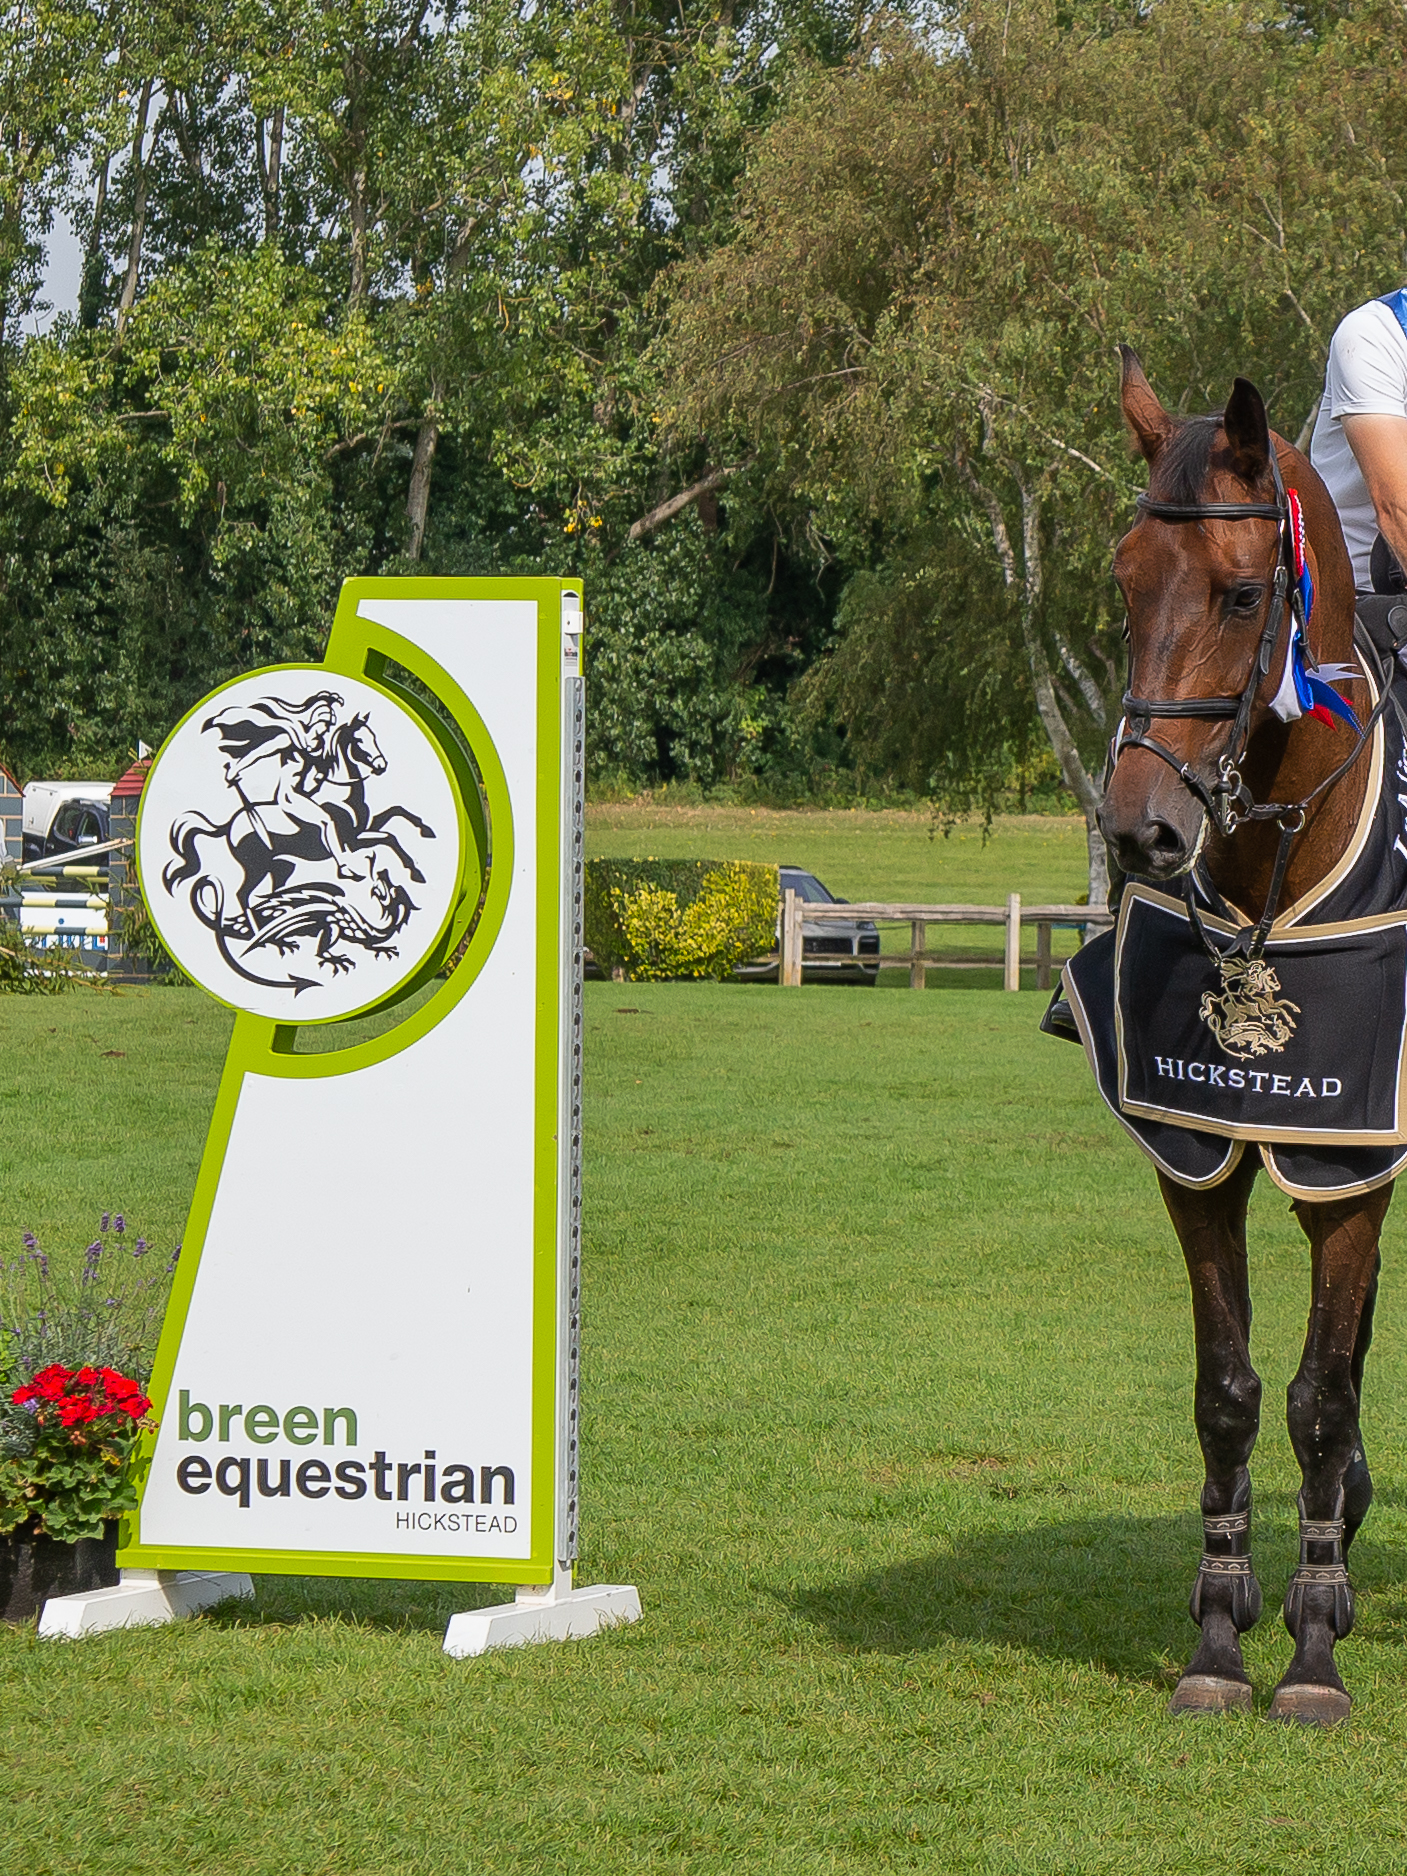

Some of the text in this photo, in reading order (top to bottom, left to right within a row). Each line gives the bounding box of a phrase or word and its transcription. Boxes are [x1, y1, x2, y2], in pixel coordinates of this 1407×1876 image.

[1154, 1056, 1343, 1098] HICKSTEAD
[178, 1388, 358, 1446] breen
[176, 1450, 515, 1508] equestrian
[395, 1512, 518, 1534] HICKSTEAD
